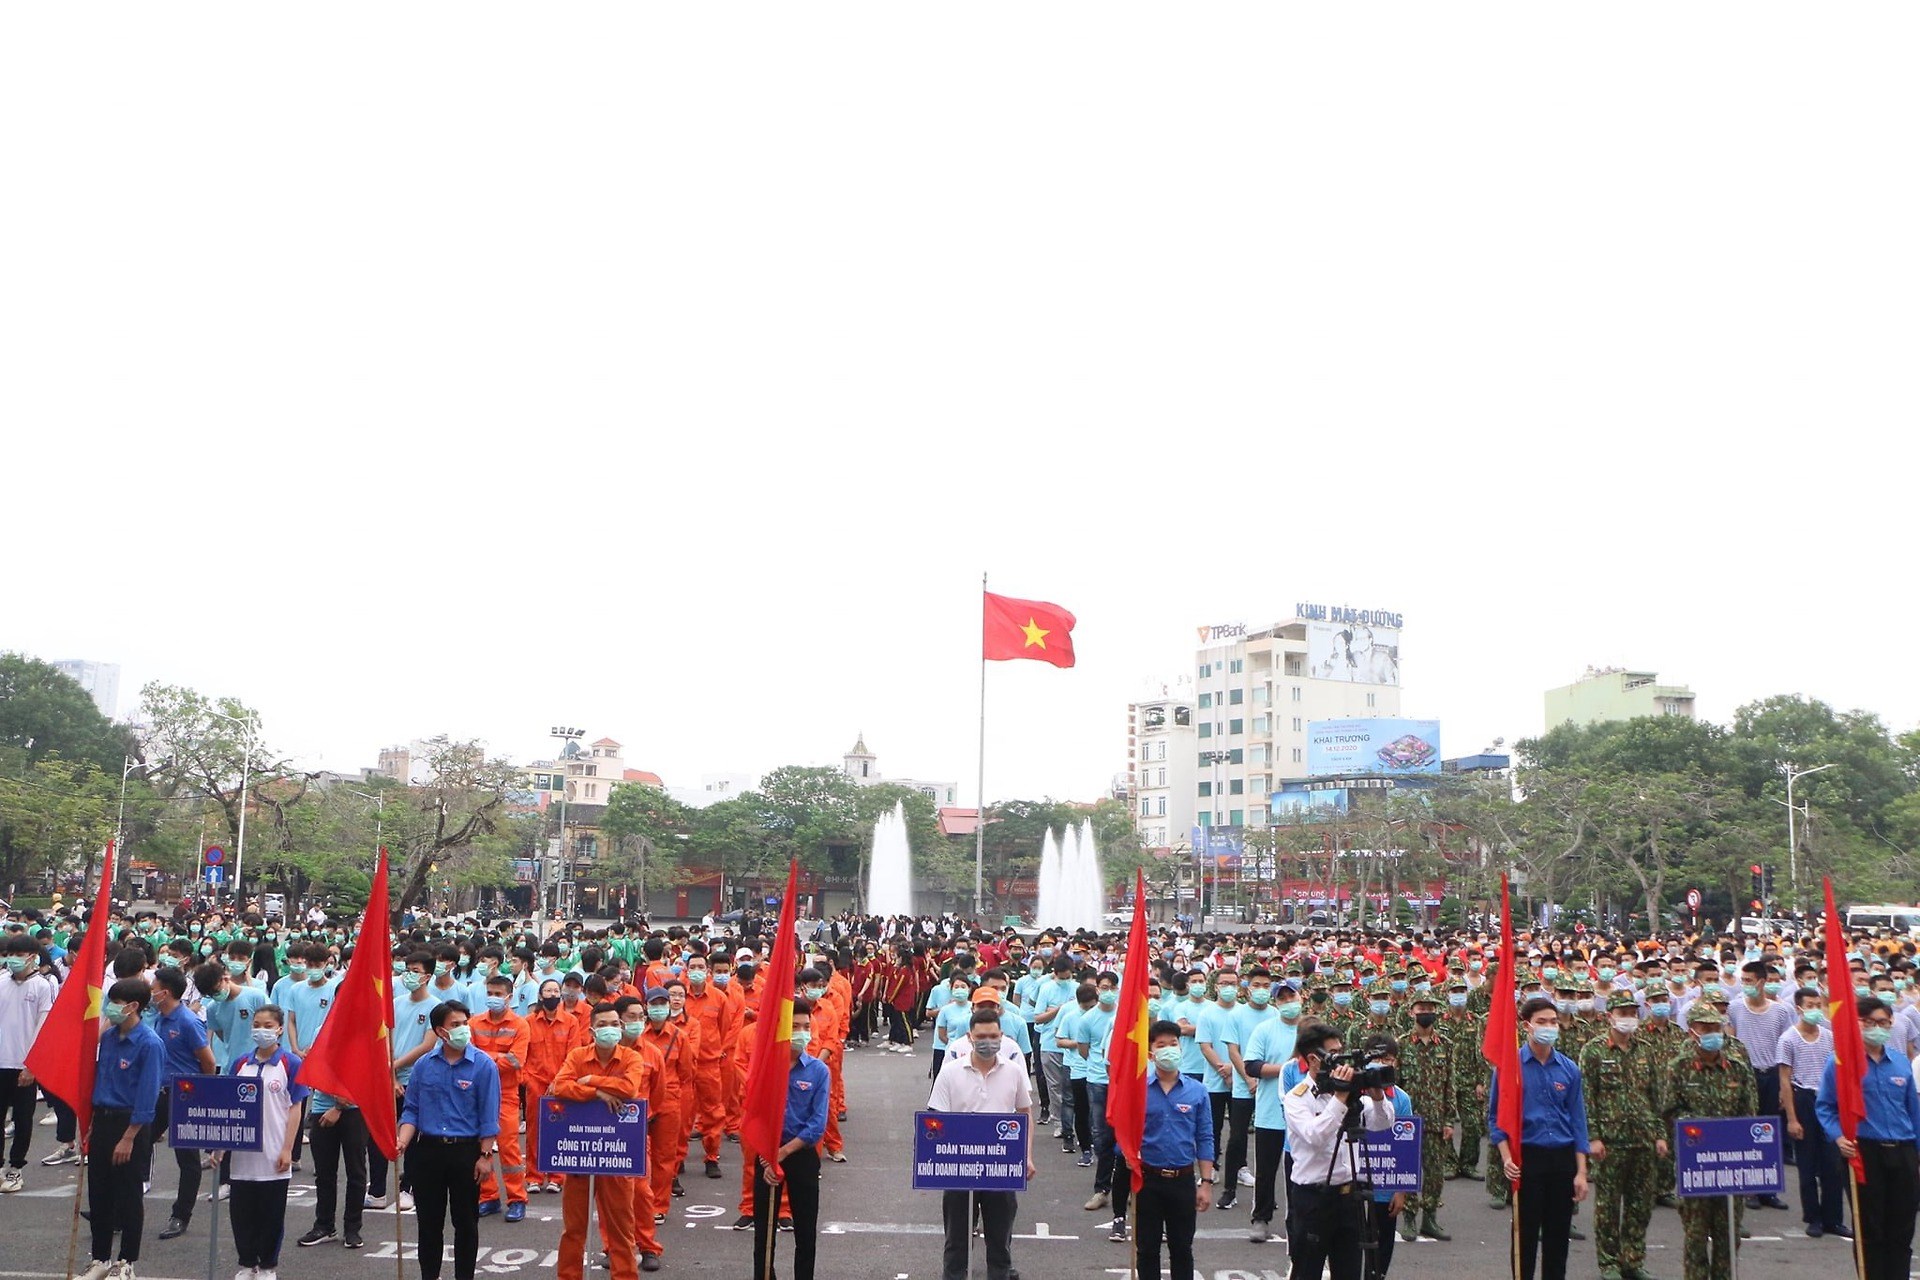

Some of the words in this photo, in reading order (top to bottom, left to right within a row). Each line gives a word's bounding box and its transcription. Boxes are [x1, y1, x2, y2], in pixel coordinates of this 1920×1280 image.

[1211, 623, 1247, 640] TPBank
[188, 1106, 206, 1117] ĐOÀN
[207, 1108, 229, 1118] THANH
[230, 1107, 246, 1119] NIÊN
[243, 1126, 256, 1142] NAM
[584, 1125, 602, 1134] THANH
[557, 1138, 579, 1151] CÔNG
[581, 1141, 590, 1151] TY
[936, 1142, 958, 1155] ĐOÀN
[960, 1144, 986, 1155] THANH
[987, 1143, 1007, 1155] NIÊN
[551, 1152, 578, 1167] CẢNG
[580, 1153, 597, 1167] HẢI
[599, 1155, 632, 1169] PHÒNG
[1696, 1150, 1718, 1163] ĐOÀN
[1718, 1151, 1743, 1162] THANH
[1744, 1149, 1763, 1161] NIÊN
[917, 1158, 934, 1176] KHỐI
[935, 1162, 958, 1176] DOANH
[959, 1161, 984, 1179] NGHIỆP
[986, 1161, 1008, 1177] THÀNH
[1009, 1159, 1023, 1178] PHỐ
[1381, 1157, 1396, 1171] HỌC
[1386, 1170, 1396, 1185] HẢI
[1397, 1171, 1417, 1185] PHÒNG
[1743, 1165, 1764, 1186] THÀNH
